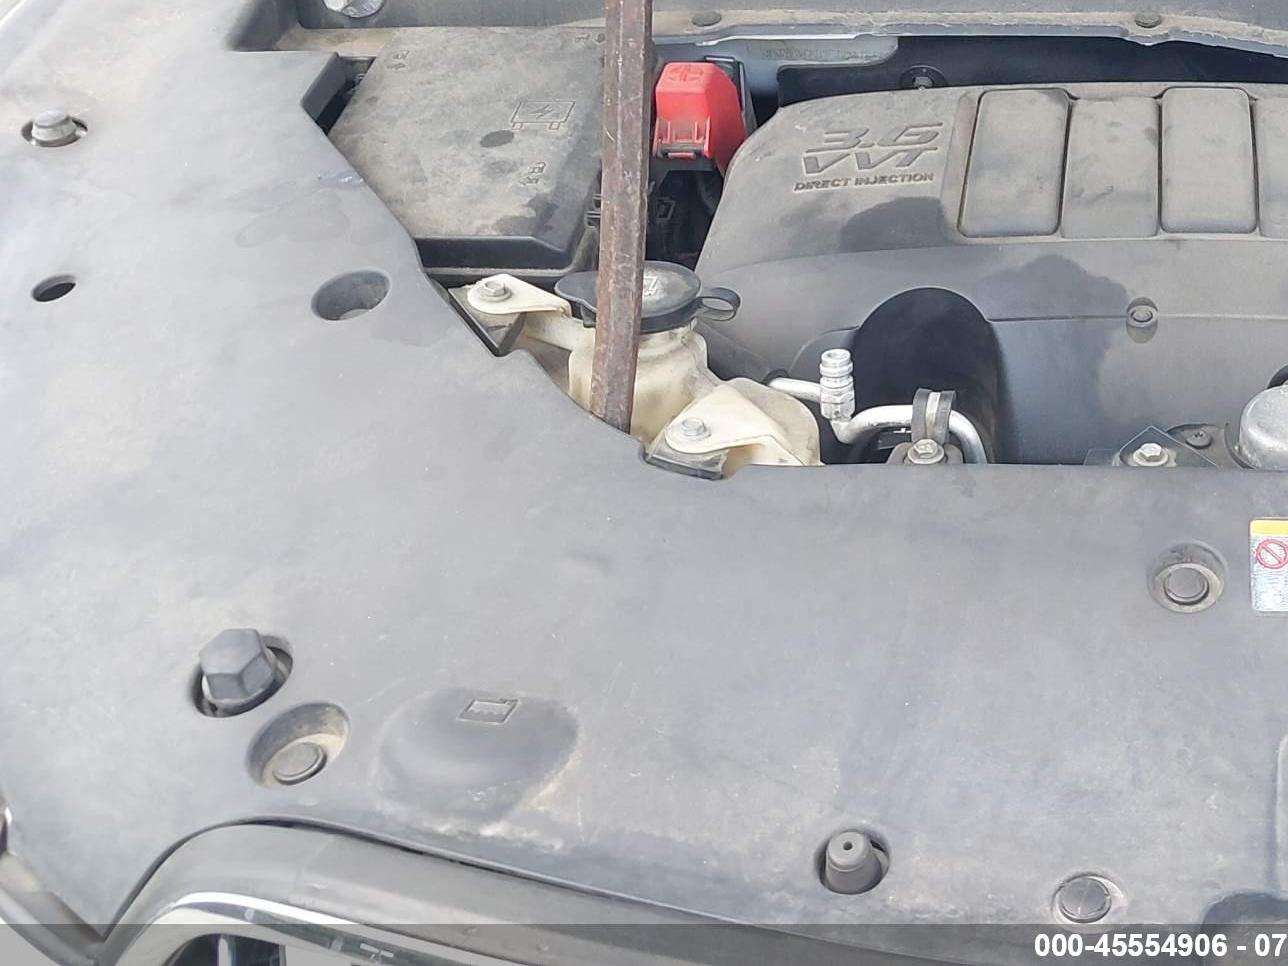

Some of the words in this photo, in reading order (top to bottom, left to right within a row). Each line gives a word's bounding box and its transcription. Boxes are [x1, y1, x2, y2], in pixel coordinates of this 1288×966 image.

[805, 122, 943, 154] 3.6
[793, 177, 852, 192] DIRECT
[854, 172, 935, 187] INJECTION
